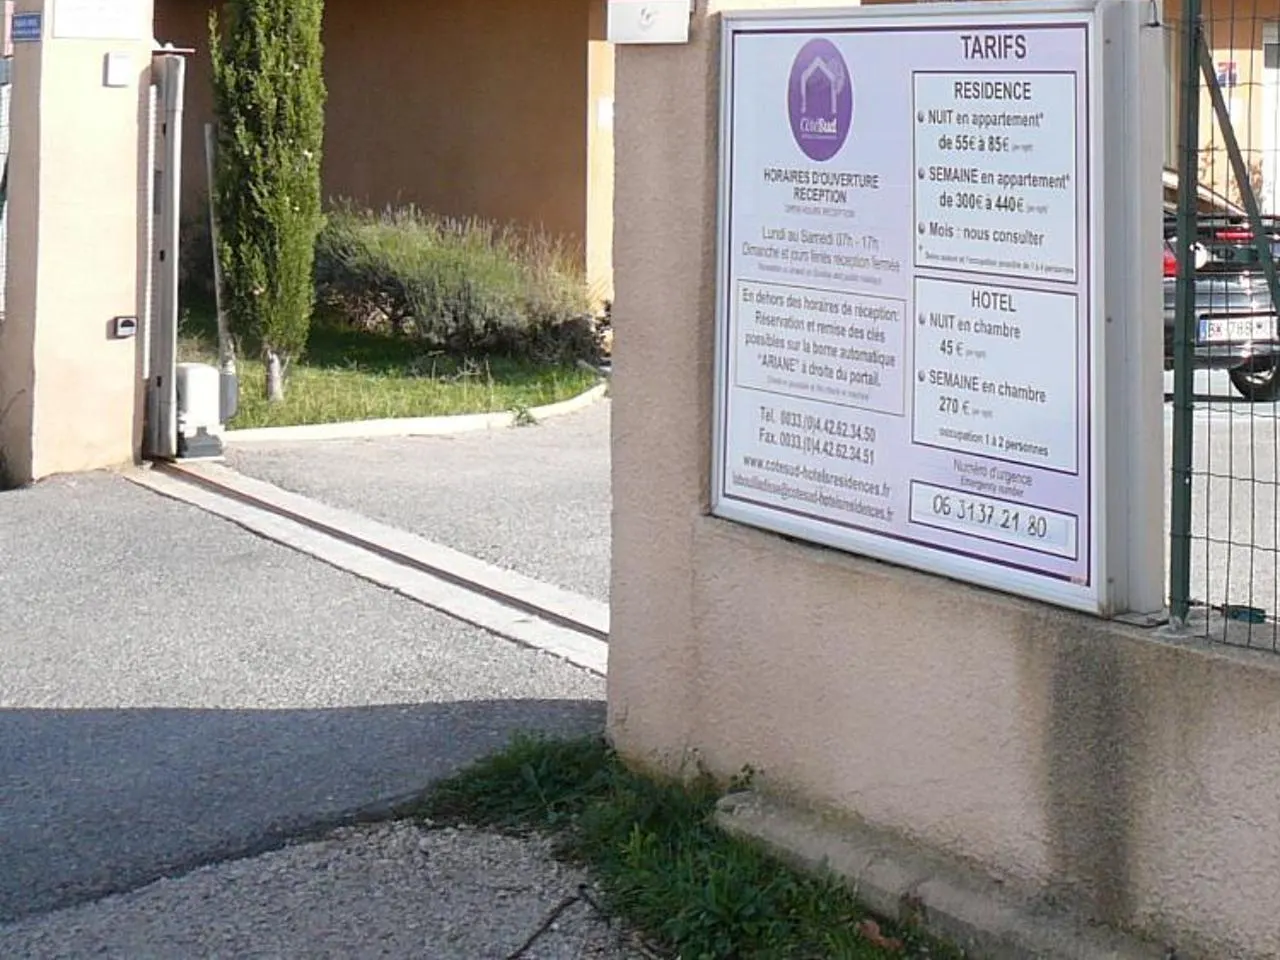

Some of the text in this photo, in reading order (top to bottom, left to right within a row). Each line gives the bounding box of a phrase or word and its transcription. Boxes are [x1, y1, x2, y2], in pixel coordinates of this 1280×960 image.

[961, 34, 1027, 60] TARIFS
[954, 81, 1032, 100] RESIDENCE
[928, 109, 953, 125] NUIT
[956, 113, 970, 125] en
[938, 133, 953, 150] de
[955, 134, 977, 151] 55€
[987, 135, 1010, 152] 85€
[763, 168, 880, 189] HORAIRES D'OUVERTURE
[929, 166, 978, 183] SEMAINE
[980, 172, 994, 184] en
[793, 187, 847, 203] RECEPTION
[939, 192, 953, 208] de
[956, 192, 983, 210] 300€
[994, 195, 1024, 213] 440€
[762, 225, 786, 241] Lundi
[929, 221, 954, 238] Mois
[963, 227, 989, 241] nous
[992, 229, 1044, 247] consulter
[742, 287, 755, 302] En
[755, 289, 784, 307] dehors
[787, 294, 802, 309] des
[803, 295, 839, 314] horaires
[971, 289, 1017, 313] HOTEL
[929, 312, 1021, 339] NUIT en chambre
[939, 339, 953, 356] 45
[956, 341, 965, 357] €
[808, 361, 834, 379] droite
[836, 367, 848, 381] du
[929, 368, 1046, 403] SEMAINE en chambre
[939, 395, 958, 414] 270
[998, 435, 1005, 448] 2
[932, 493, 951, 516] 06
[1027, 514, 1047, 538] 80
